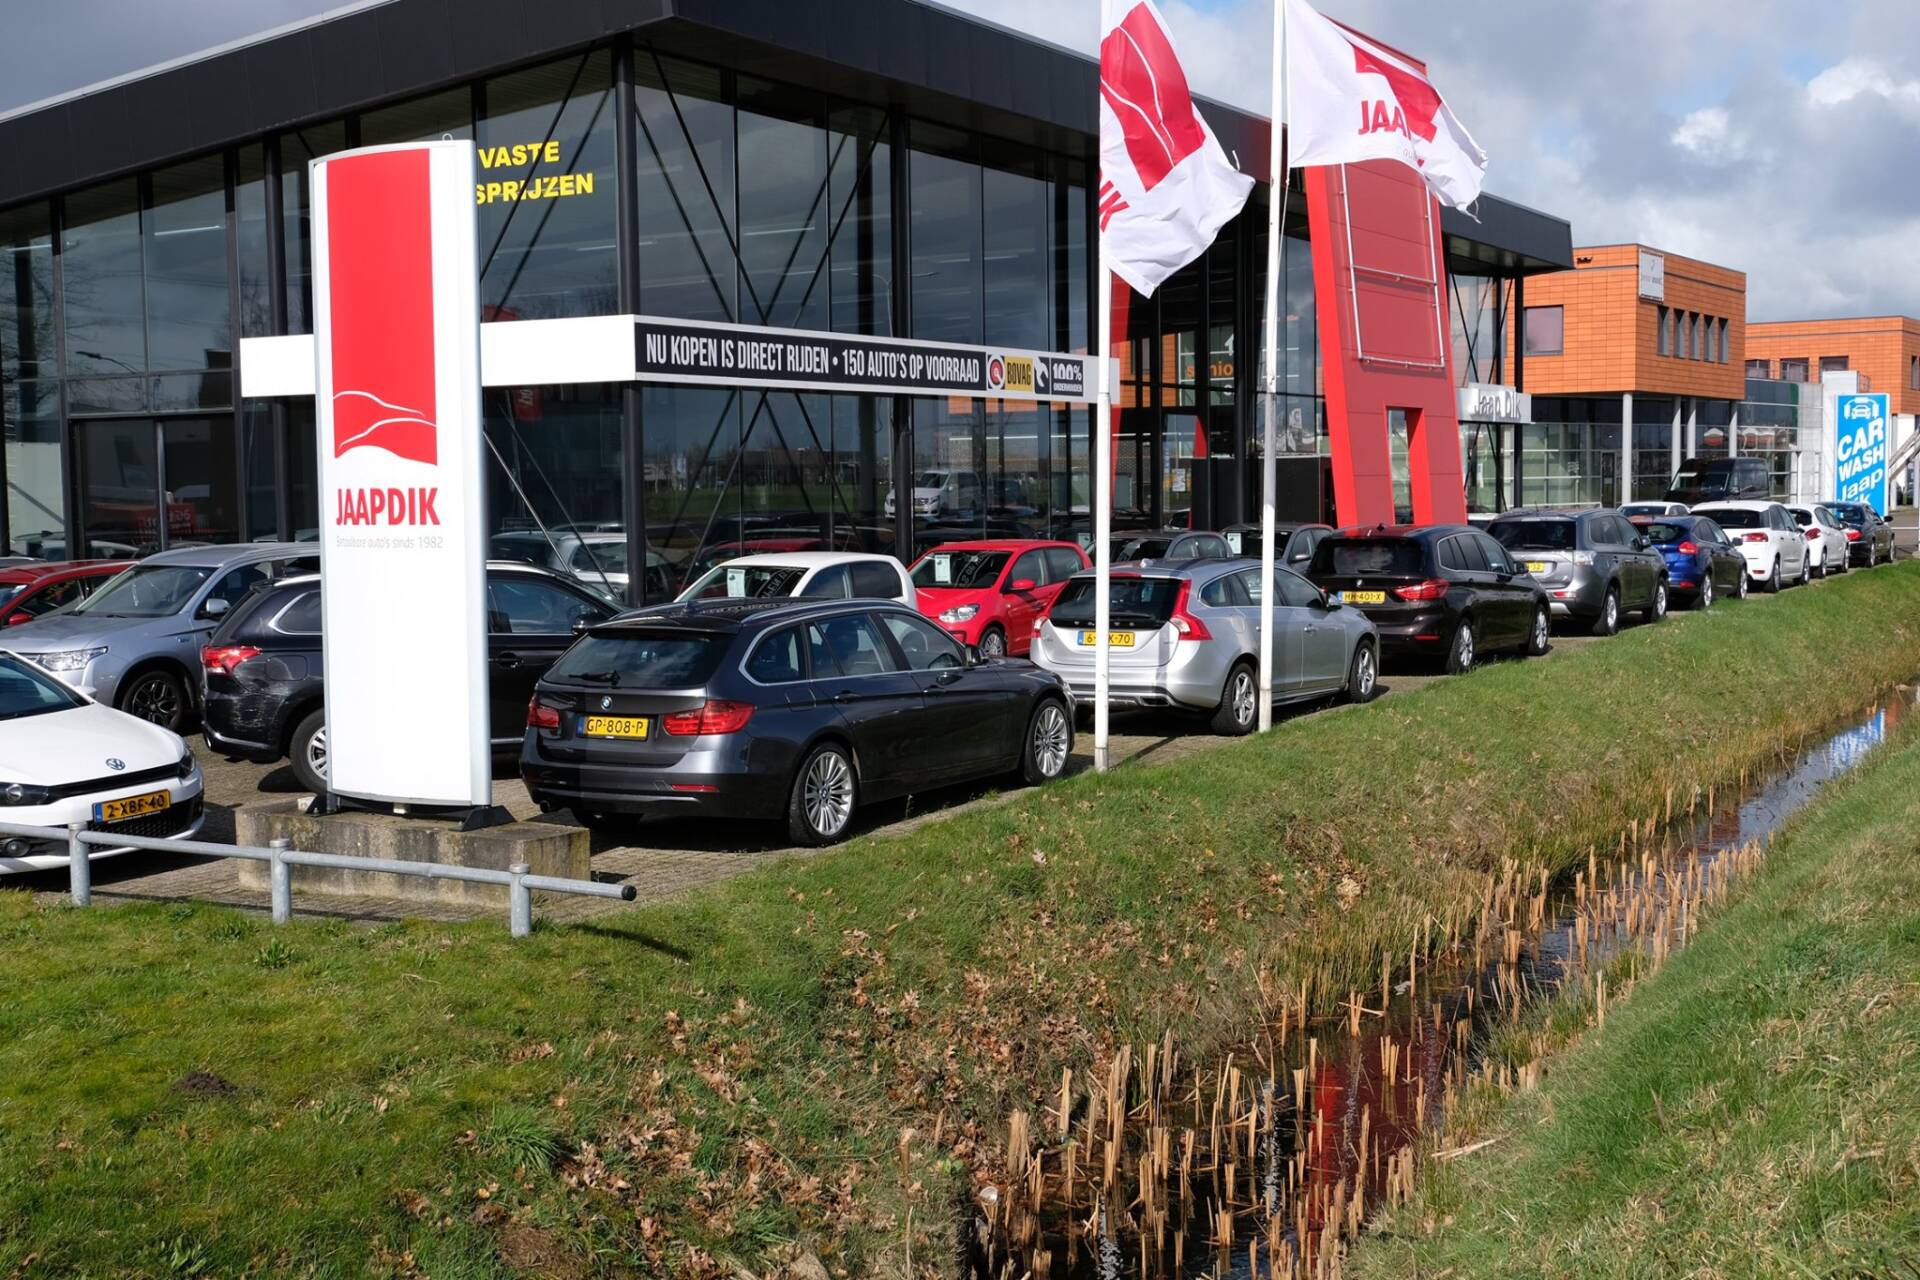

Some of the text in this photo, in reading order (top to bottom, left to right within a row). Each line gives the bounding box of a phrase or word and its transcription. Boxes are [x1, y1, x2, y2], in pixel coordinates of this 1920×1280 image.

[1358, 99, 1411, 140] JAA
[478, 141, 560, 169] VASTE
[646, 333, 980, 383] NU KOPEN IS DIRECT RIJDEN 150 AUTO'S OP VOORRAAD
[1007, 362, 1032, 386] BOVAG
[1053, 362, 1082, 381] 100%
[1470, 388, 1521, 421] Jaap Dik
[1838, 417, 1884, 462] CAR
[1838, 443, 1884, 482] WASH
[1838, 468, 1884, 502] Jaap
[336, 487, 441, 526] JAAPDIK
[418, 535, 444, 549] 1982
[587, 718, 643, 734] GP-808-P
[107, 794, 165, 818] 2-XBF-40
